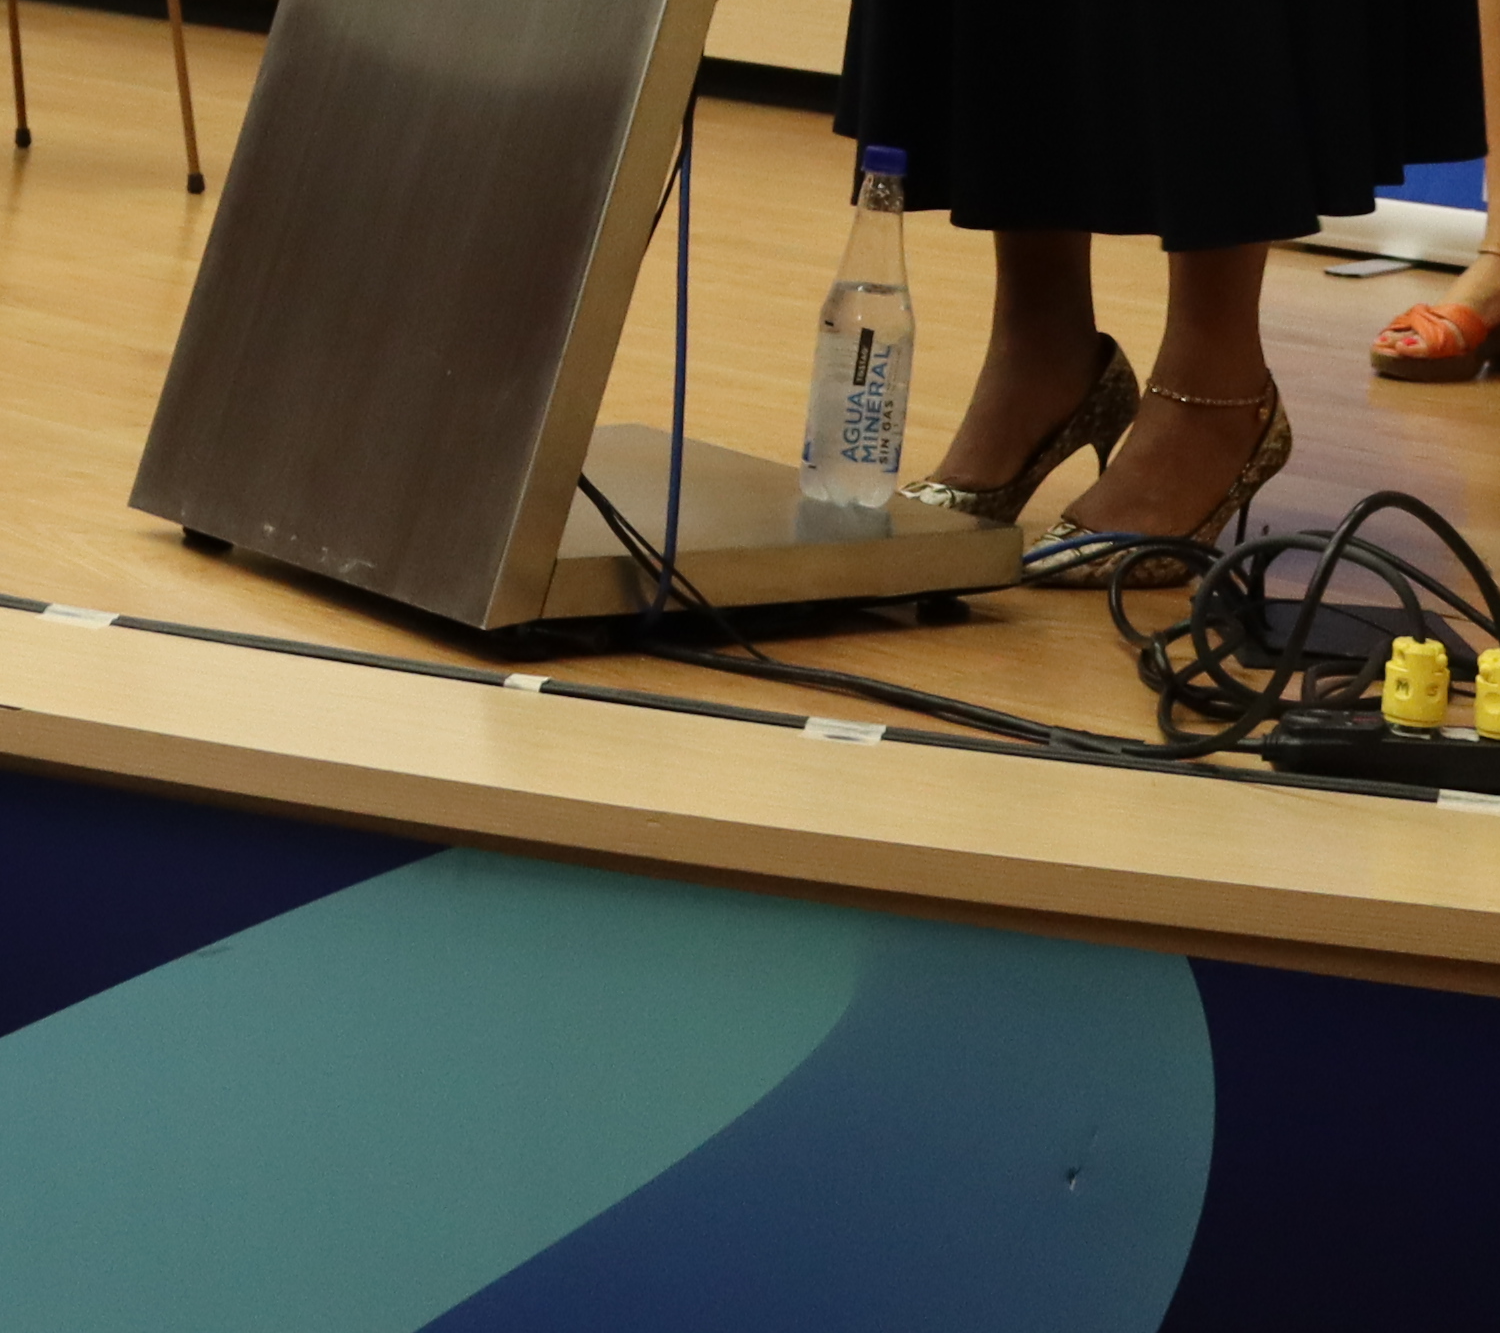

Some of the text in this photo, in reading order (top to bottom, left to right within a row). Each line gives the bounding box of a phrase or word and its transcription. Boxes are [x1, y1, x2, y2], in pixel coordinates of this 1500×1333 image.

[840, 390, 866, 464] AGUA
[860, 344, 892, 464] MINERAL
[881, 399, 895, 432] GAS
[879, 438, 891, 465] SIN
